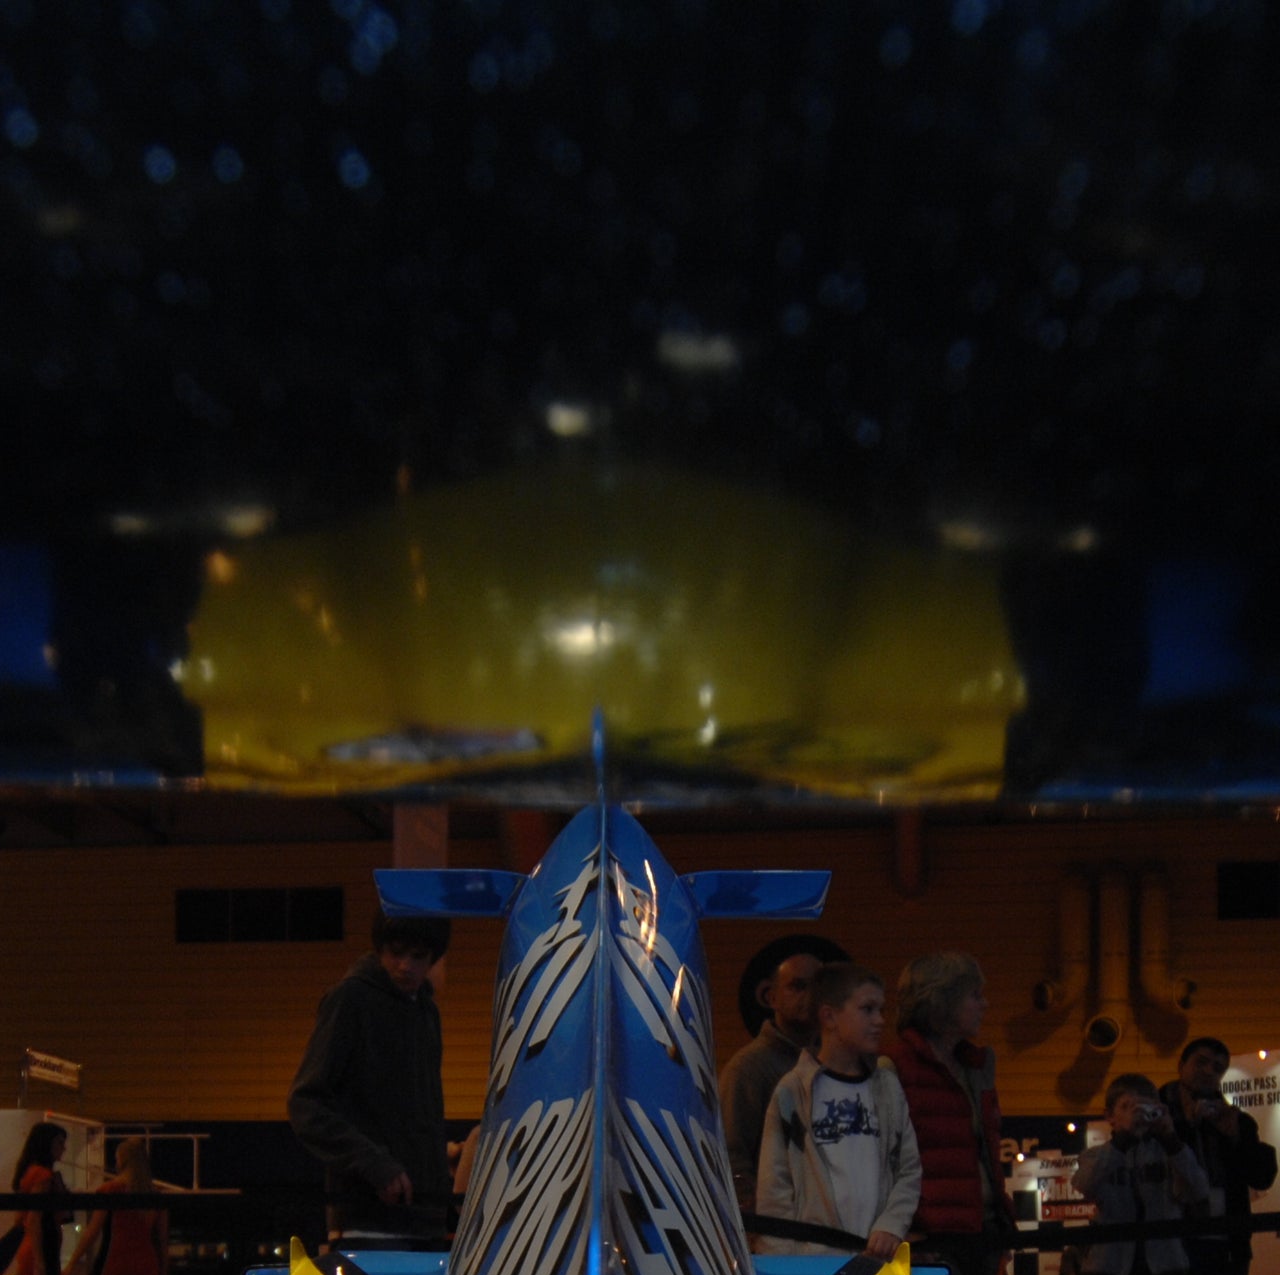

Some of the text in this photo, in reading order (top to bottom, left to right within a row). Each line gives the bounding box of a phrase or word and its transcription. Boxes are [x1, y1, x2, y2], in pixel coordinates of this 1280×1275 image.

[1223, 1076, 1277, 1095] DDOCK PASS
[1232, 1092, 1265, 1108] DRIVER
